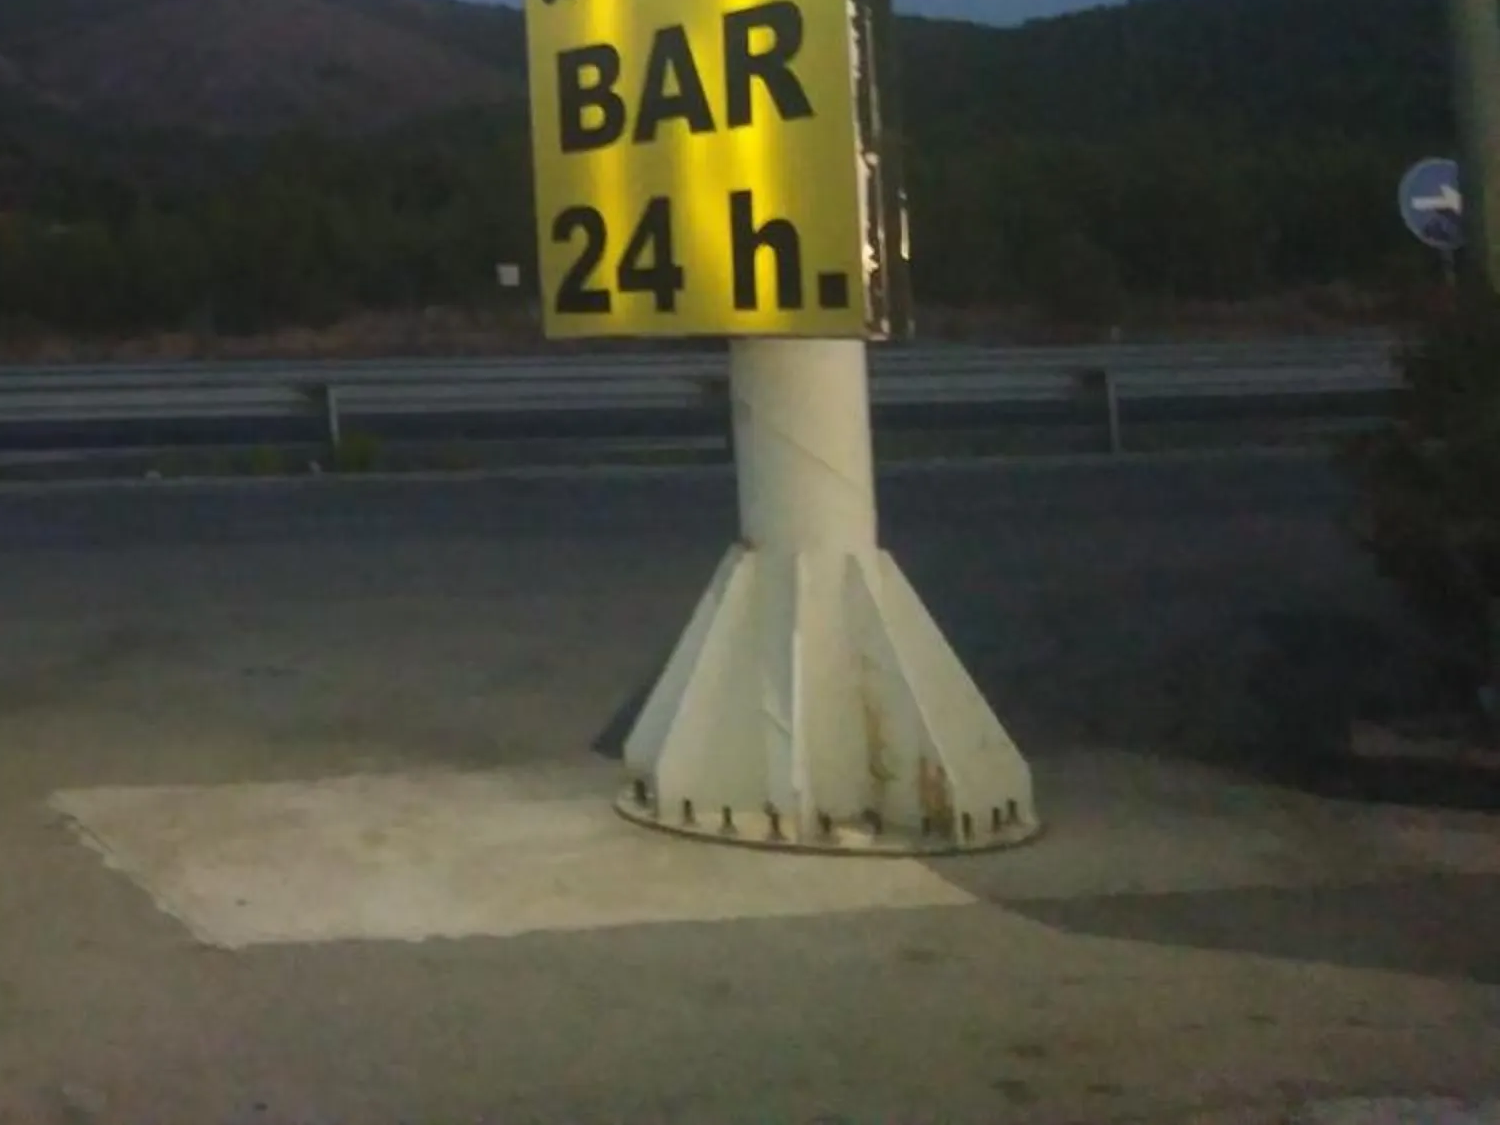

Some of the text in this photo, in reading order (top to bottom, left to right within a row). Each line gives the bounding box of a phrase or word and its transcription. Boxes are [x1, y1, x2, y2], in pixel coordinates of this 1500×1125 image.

[556, 0, 816, 155] BAR
[551, 189, 849, 314] 24 h.
